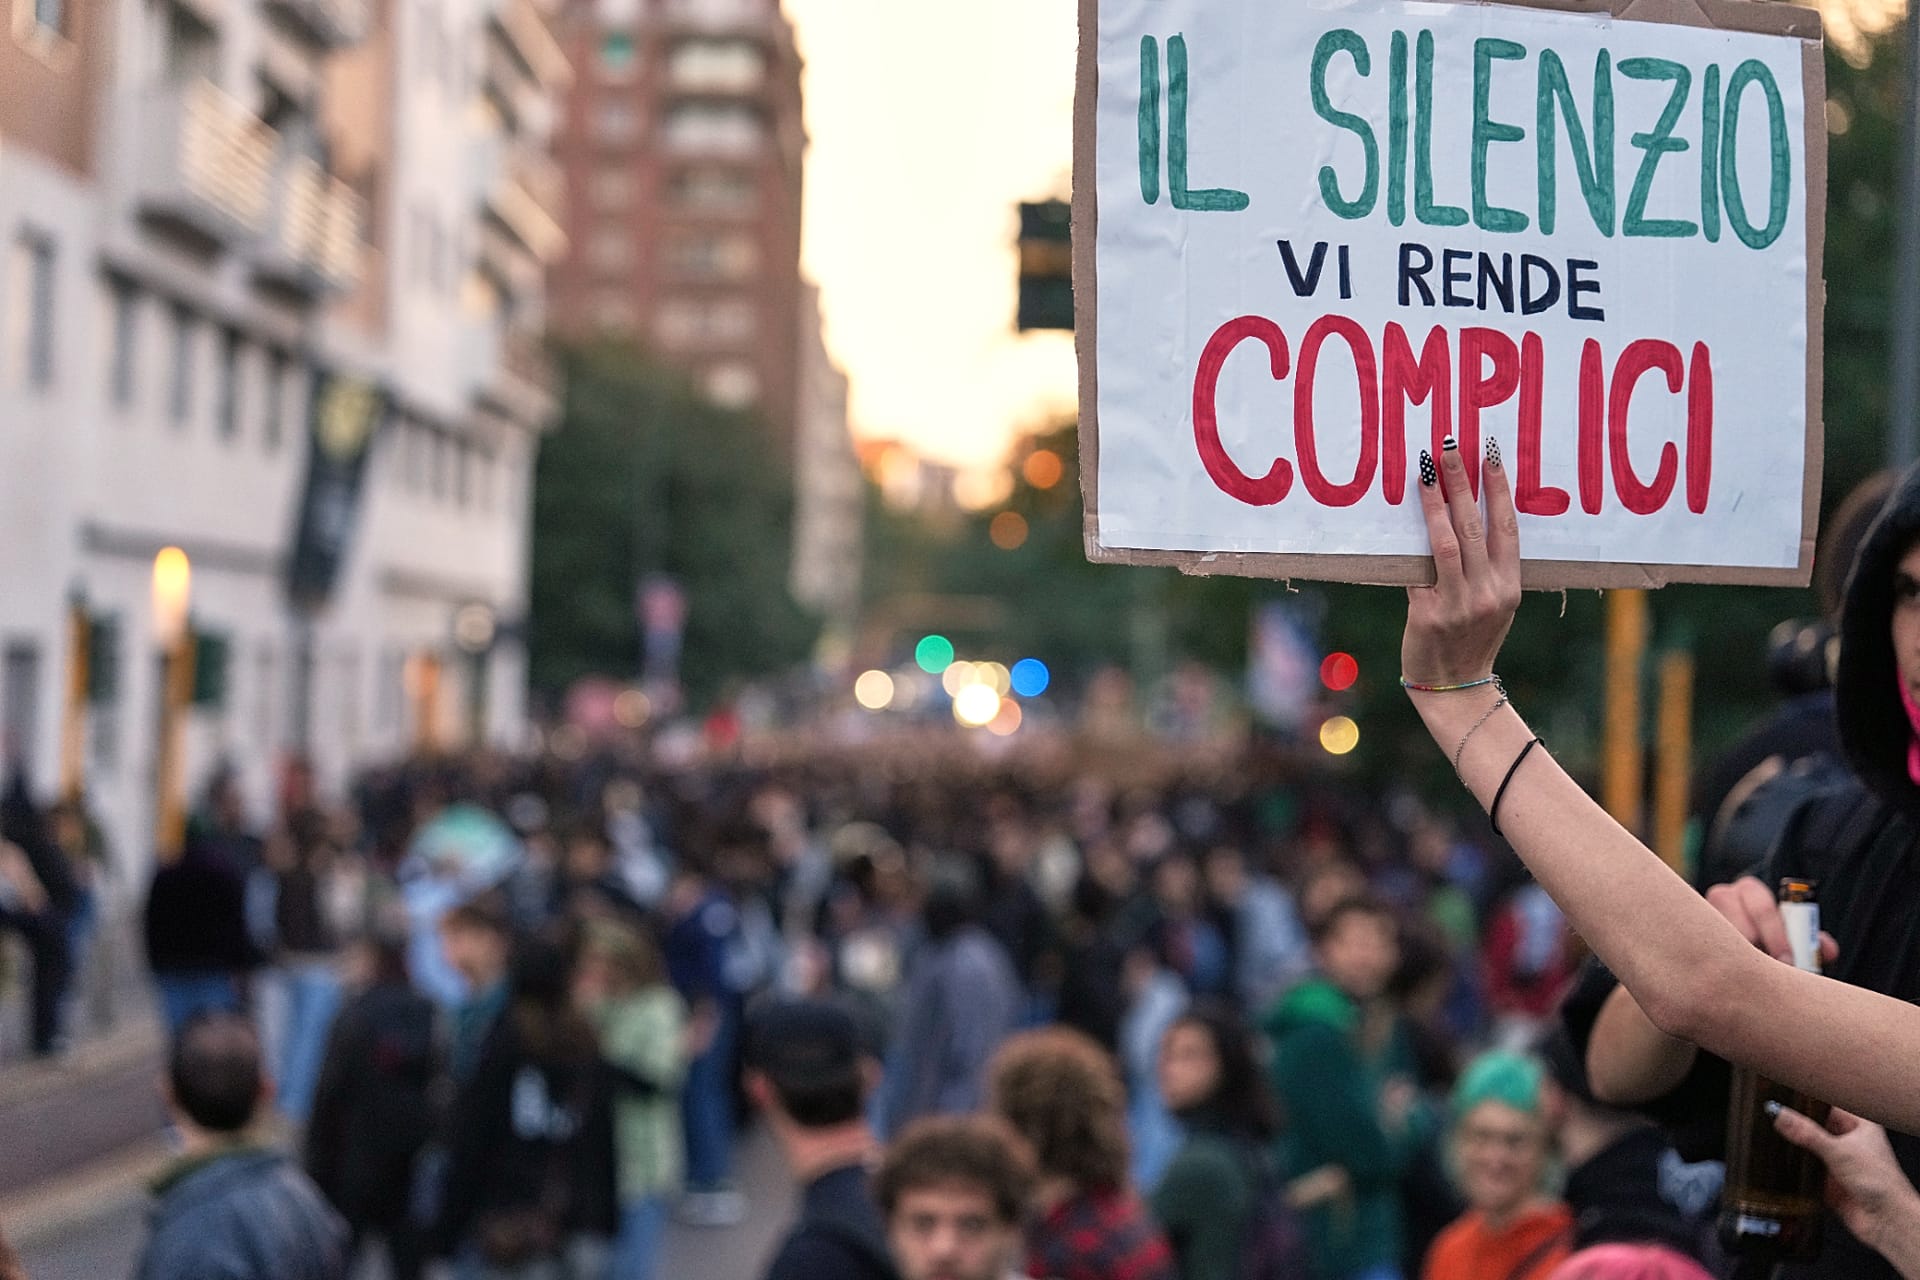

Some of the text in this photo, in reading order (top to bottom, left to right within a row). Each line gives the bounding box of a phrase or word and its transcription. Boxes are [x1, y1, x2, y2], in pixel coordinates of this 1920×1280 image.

[1138, 29, 1791, 250] IL SILENZIO
[1277, 240, 1605, 322] VI RENDE
[1192, 314, 1713, 517] COMPLICI
